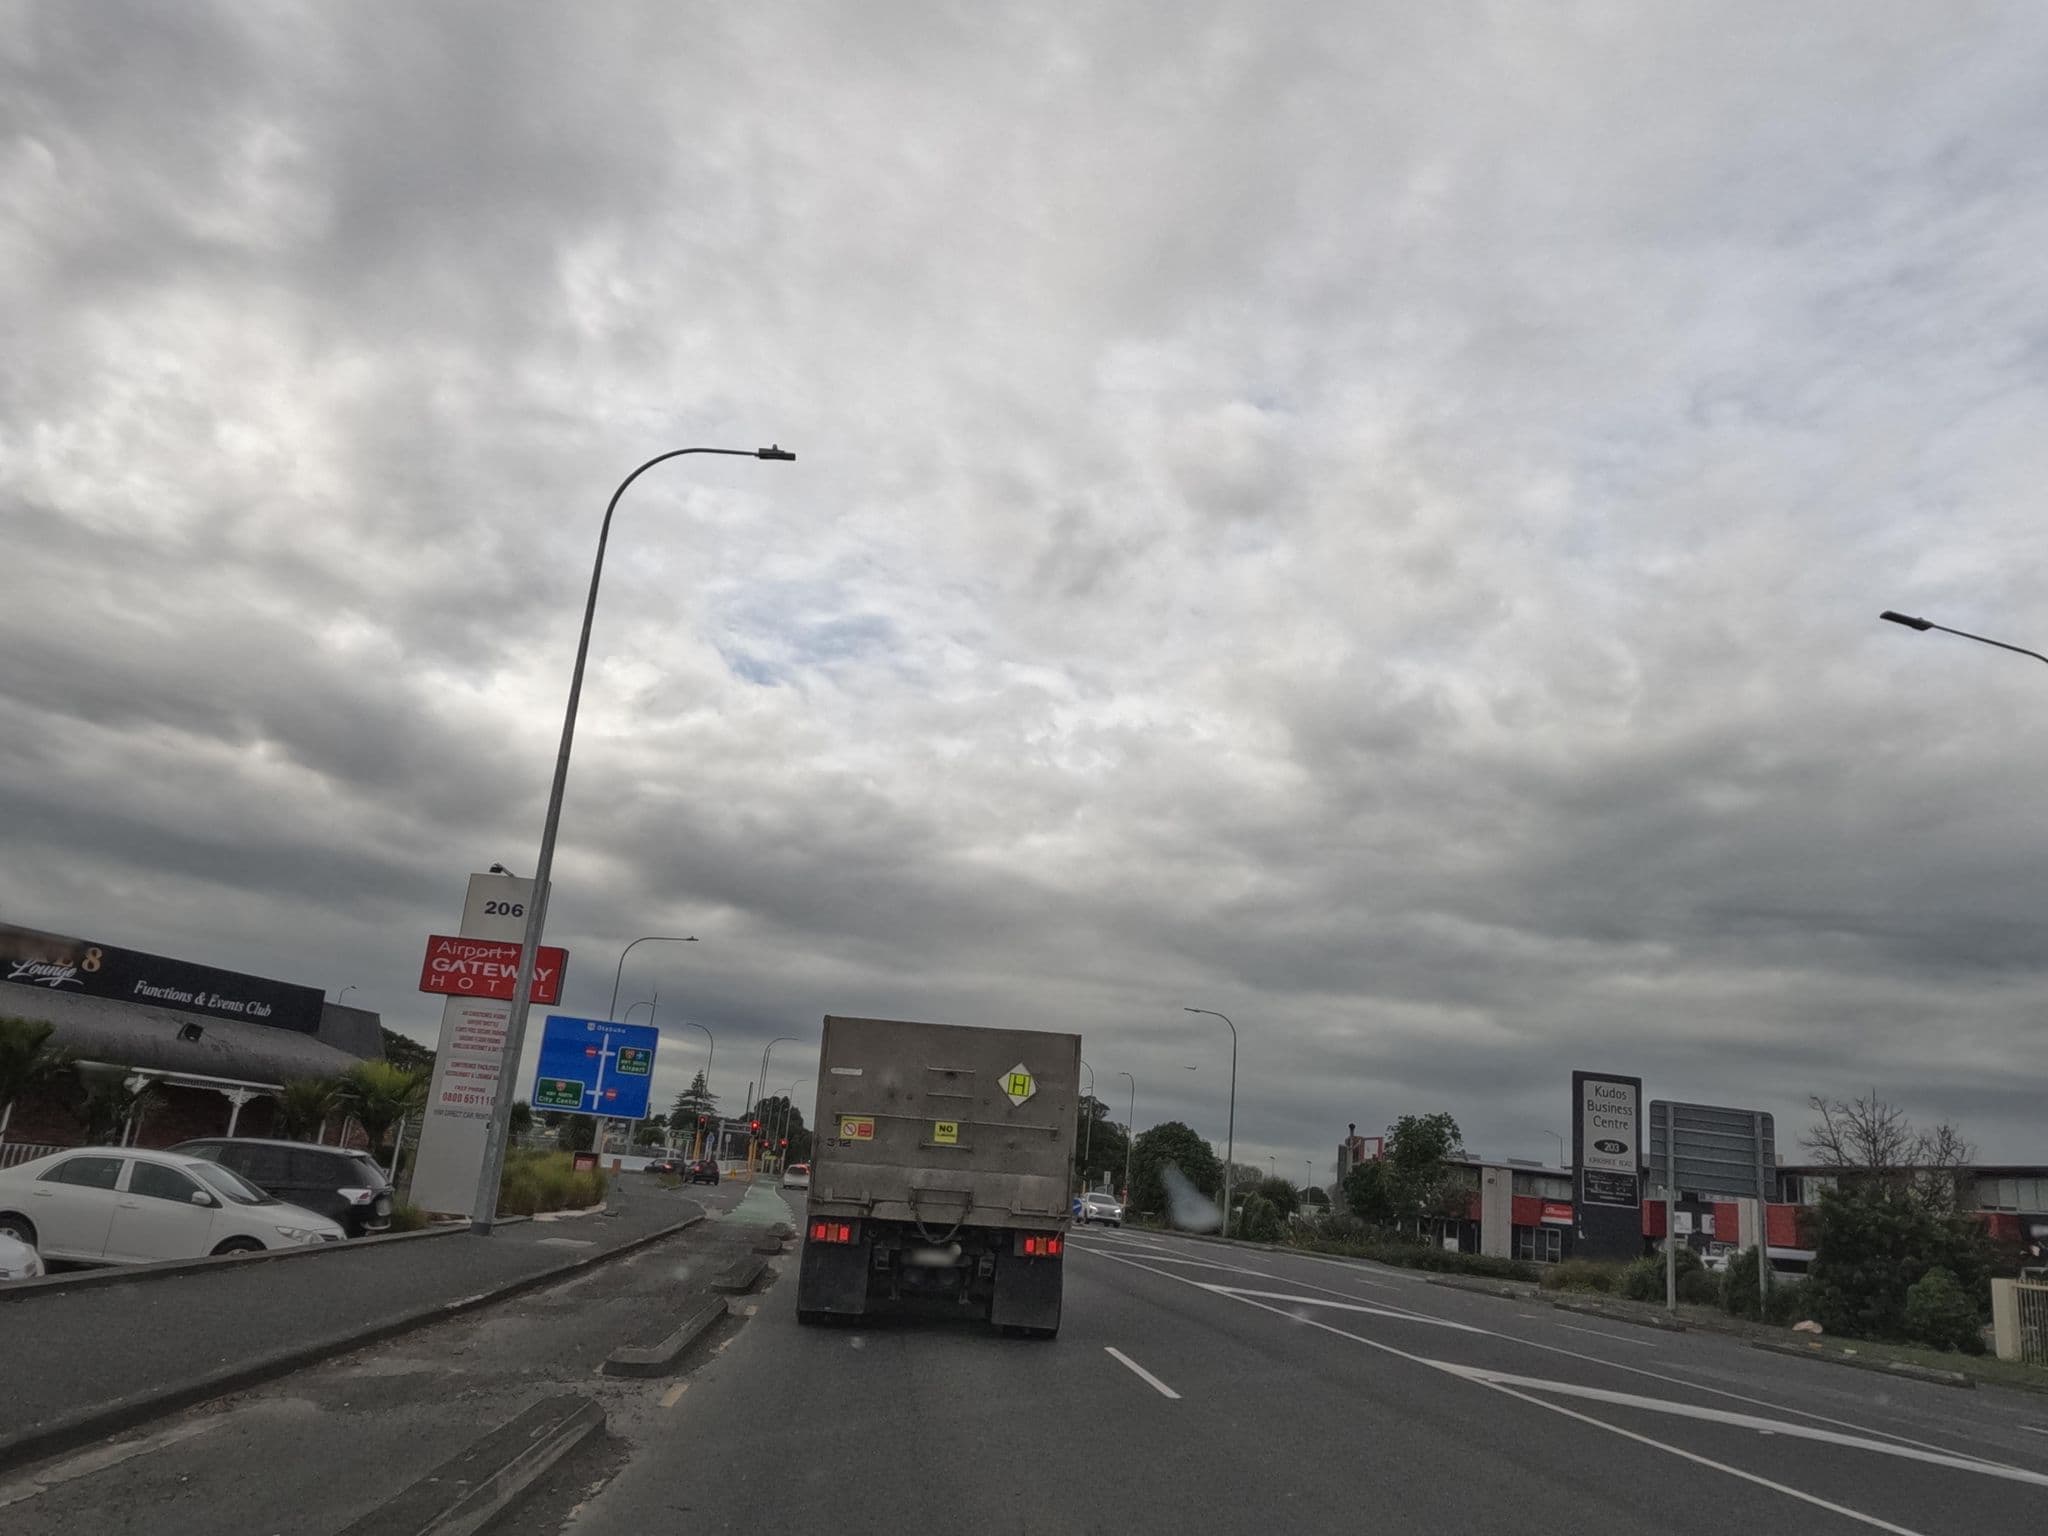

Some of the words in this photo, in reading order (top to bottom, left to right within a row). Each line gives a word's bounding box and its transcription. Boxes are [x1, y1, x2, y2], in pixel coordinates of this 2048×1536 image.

[485, 901, 524, 917] 206
[437, 941, 502, 958] Airport
[82, 947, 103, 972] 8
[7, 959, 84, 987] Lounge
[432, 957, 553, 981] GATEWY
[430, 975, 549, 997] HOTL
[134, 980, 192, 1004] Functions
[194, 992, 205, 1006] &
[208, 993, 245, 1014] Events
[246, 1000, 272, 1017] Club
[1012, 1075, 1026, 1095] H
[1594, 1085, 1628, 1100] Kudos
[442, 1091, 463, 1103] 0800
[538, 1095, 553, 1104] City
[556, 1096, 579, 1105] Centre
[1587, 1099, 1633, 1116] Business
[939, 1124, 953, 1133] NO
[1593, 1115, 1629, 1130] Centre
[1604, 1141, 1620, 1153] 203
